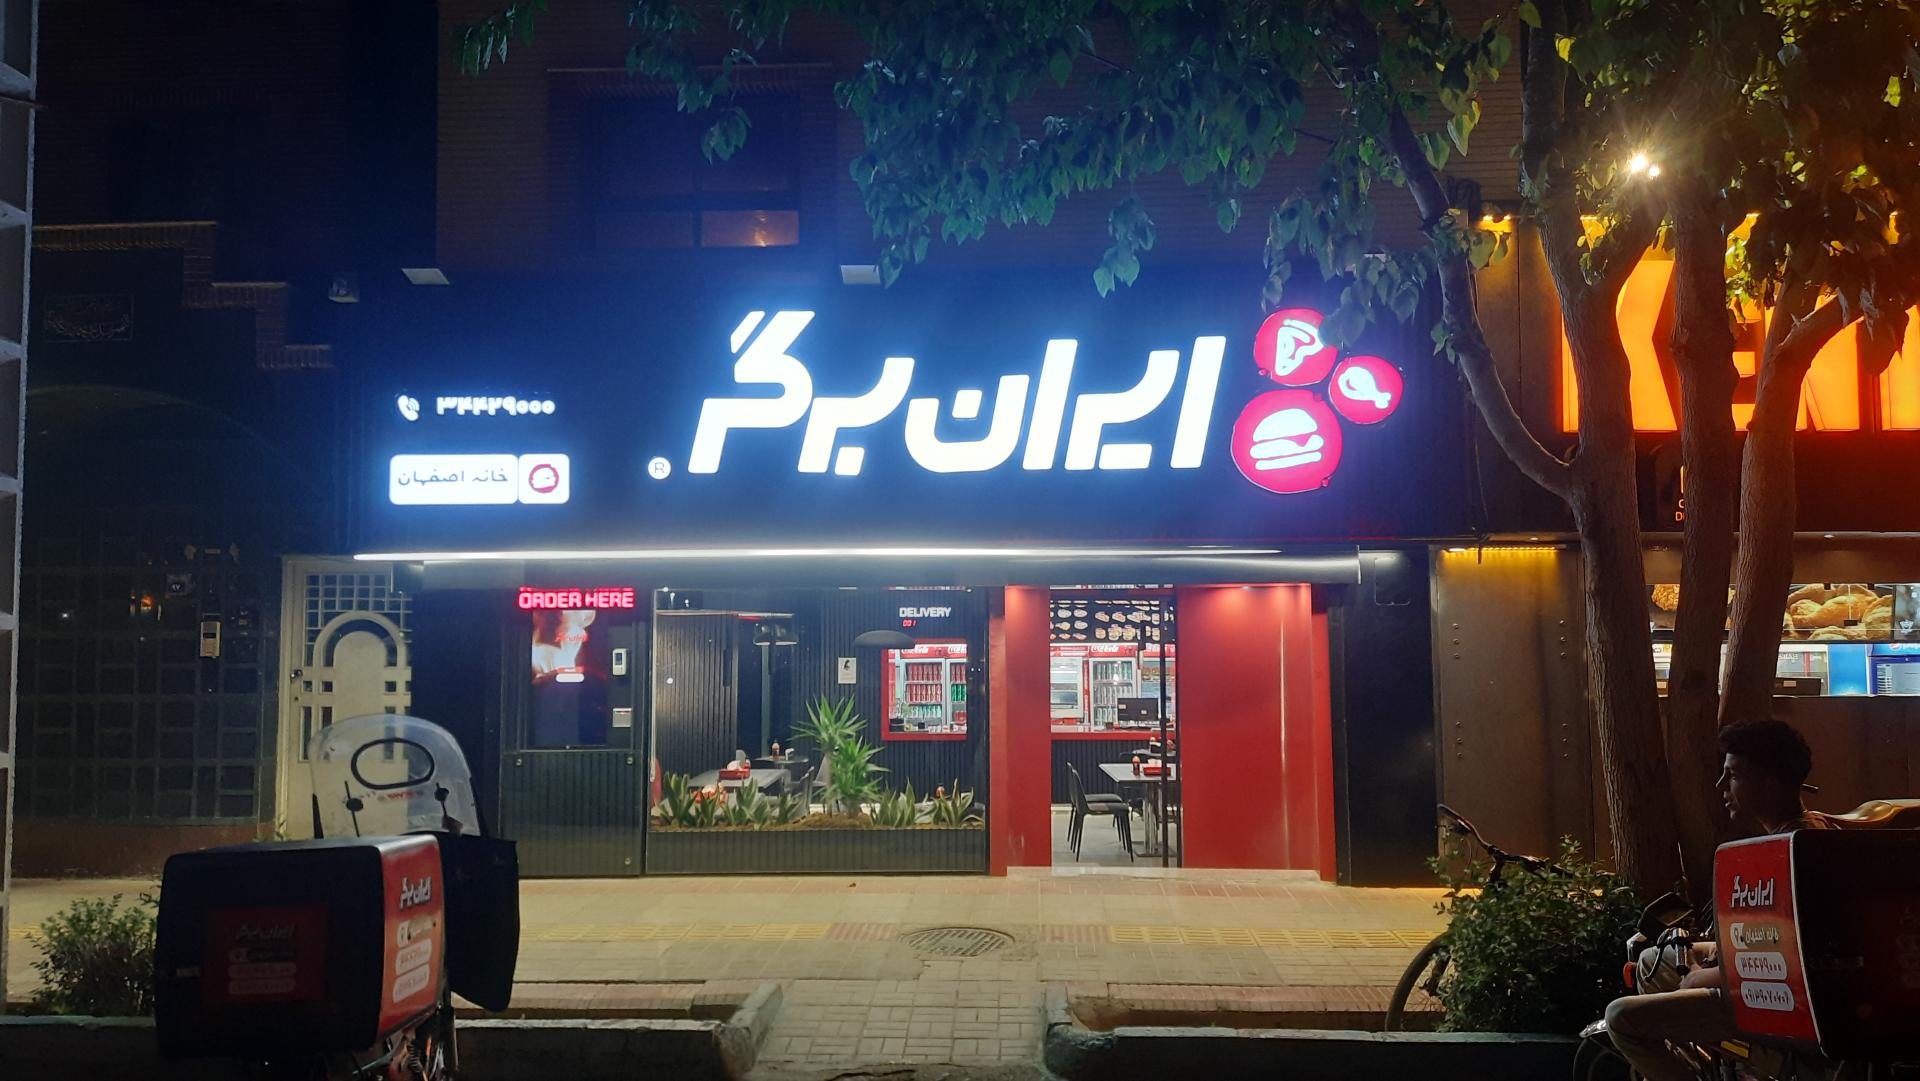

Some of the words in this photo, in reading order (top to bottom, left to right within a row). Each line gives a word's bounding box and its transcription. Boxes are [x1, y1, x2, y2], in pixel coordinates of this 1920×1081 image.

[688, 310, 915, 476] برگر
[437, 396, 555, 415] ۳۴۴۲۹۰۰۰
[905, 336, 1226, 473] ایران
[397, 468, 465, 486] اصفهان
[472, 467, 509, 482] خانه
[518, 591, 582, 609] ORDER
[585, 591, 634, 608] HERE
[899, 607, 951, 618] DELIVERY
[1731, 876, 1749, 908] برگر
[1748, 878, 1774, 906] ایران
